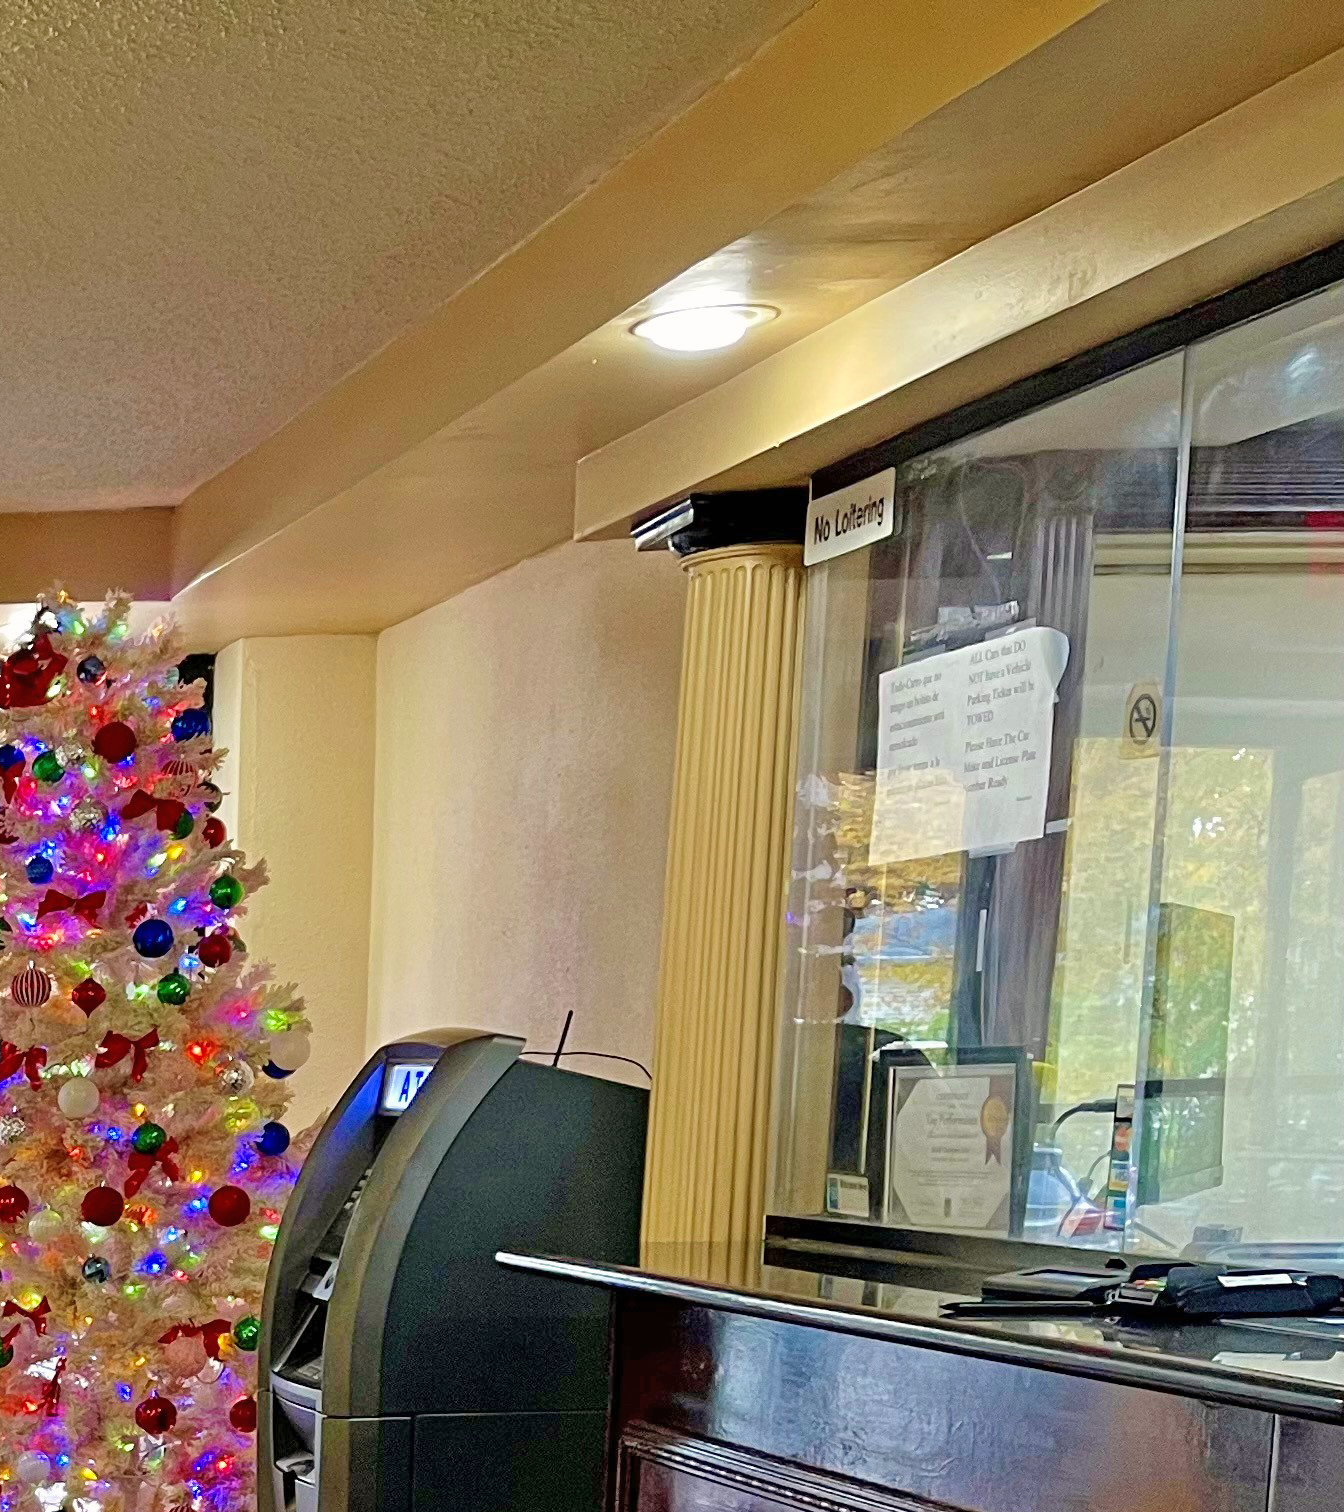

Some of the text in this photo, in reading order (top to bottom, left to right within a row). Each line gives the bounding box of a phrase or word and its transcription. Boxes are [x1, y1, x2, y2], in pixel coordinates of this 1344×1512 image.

[814, 495, 885, 545] No Loitering
[1013, 640, 1027, 653] DO
[968, 671, 984, 683] NOT
[967, 693, 992, 706] Parking
[967, 710, 994, 726] TOWED
[965, 741, 985, 753] Please
[986, 737, 1002, 748] Have
[1017, 729, 1030, 742] Car
[987, 776, 1008, 789] Ready
[398, 1070, 425, 1102] AT
